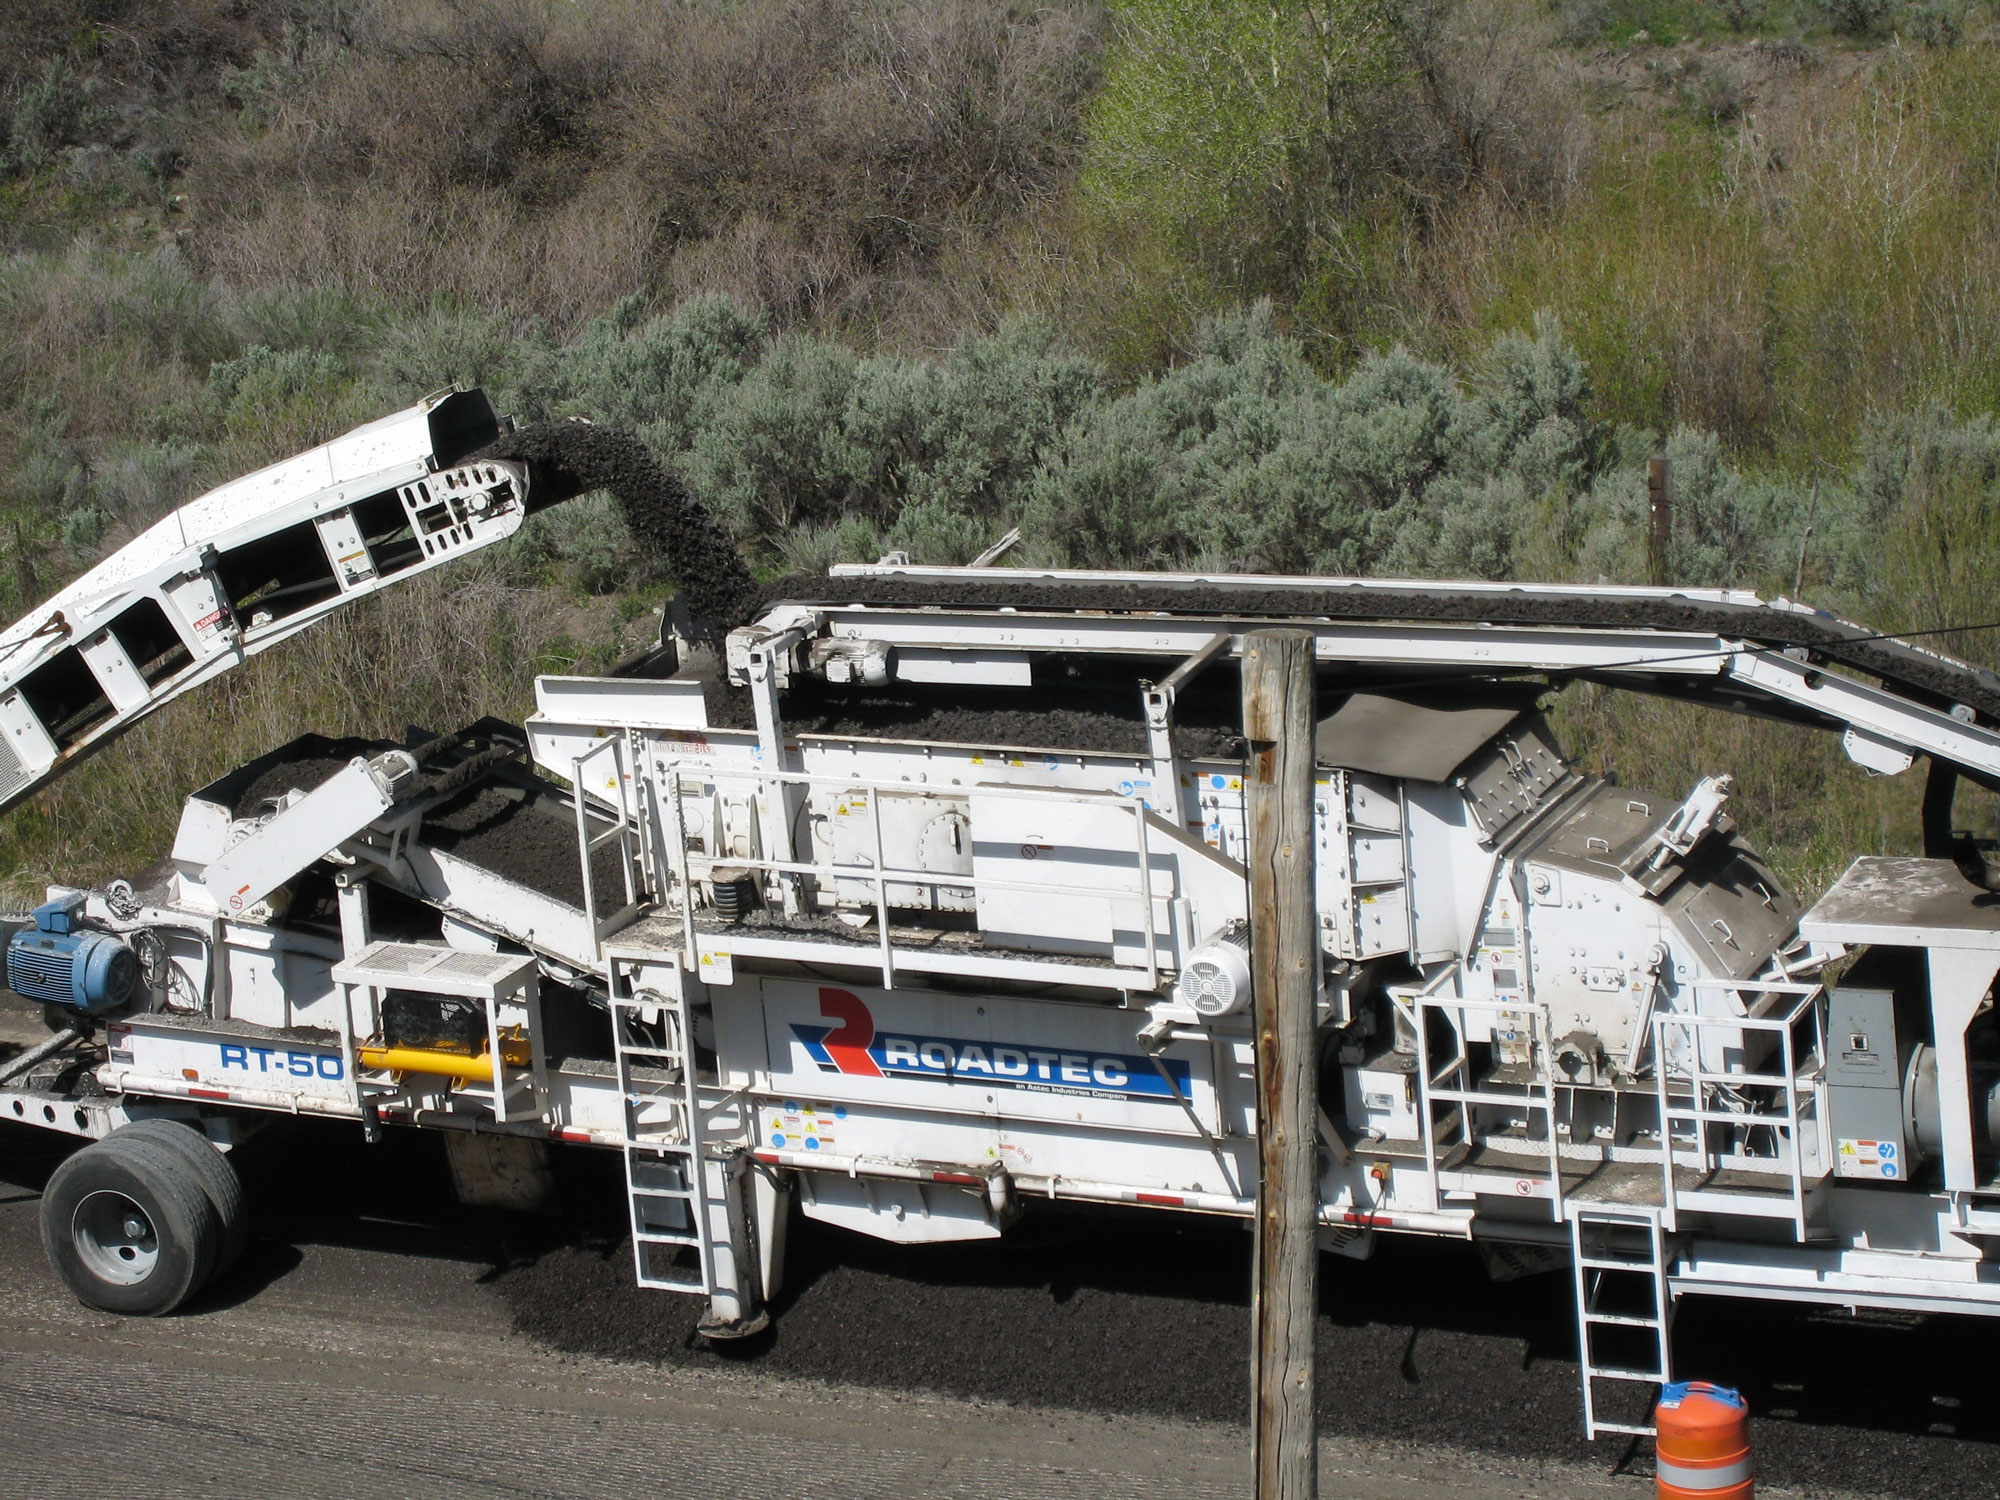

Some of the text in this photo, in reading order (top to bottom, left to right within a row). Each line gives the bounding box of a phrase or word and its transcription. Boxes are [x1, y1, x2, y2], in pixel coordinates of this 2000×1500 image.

[200, 608, 229, 626] DANG
[220, 1043, 344, 1080] RT-50
[885, 1039, 1128, 1086] ROADTEC
[1027, 1084, 1050, 1092] Astec
[1052, 1086, 1090, 1097] Industries
[1092, 1090, 1128, 1101] Company
